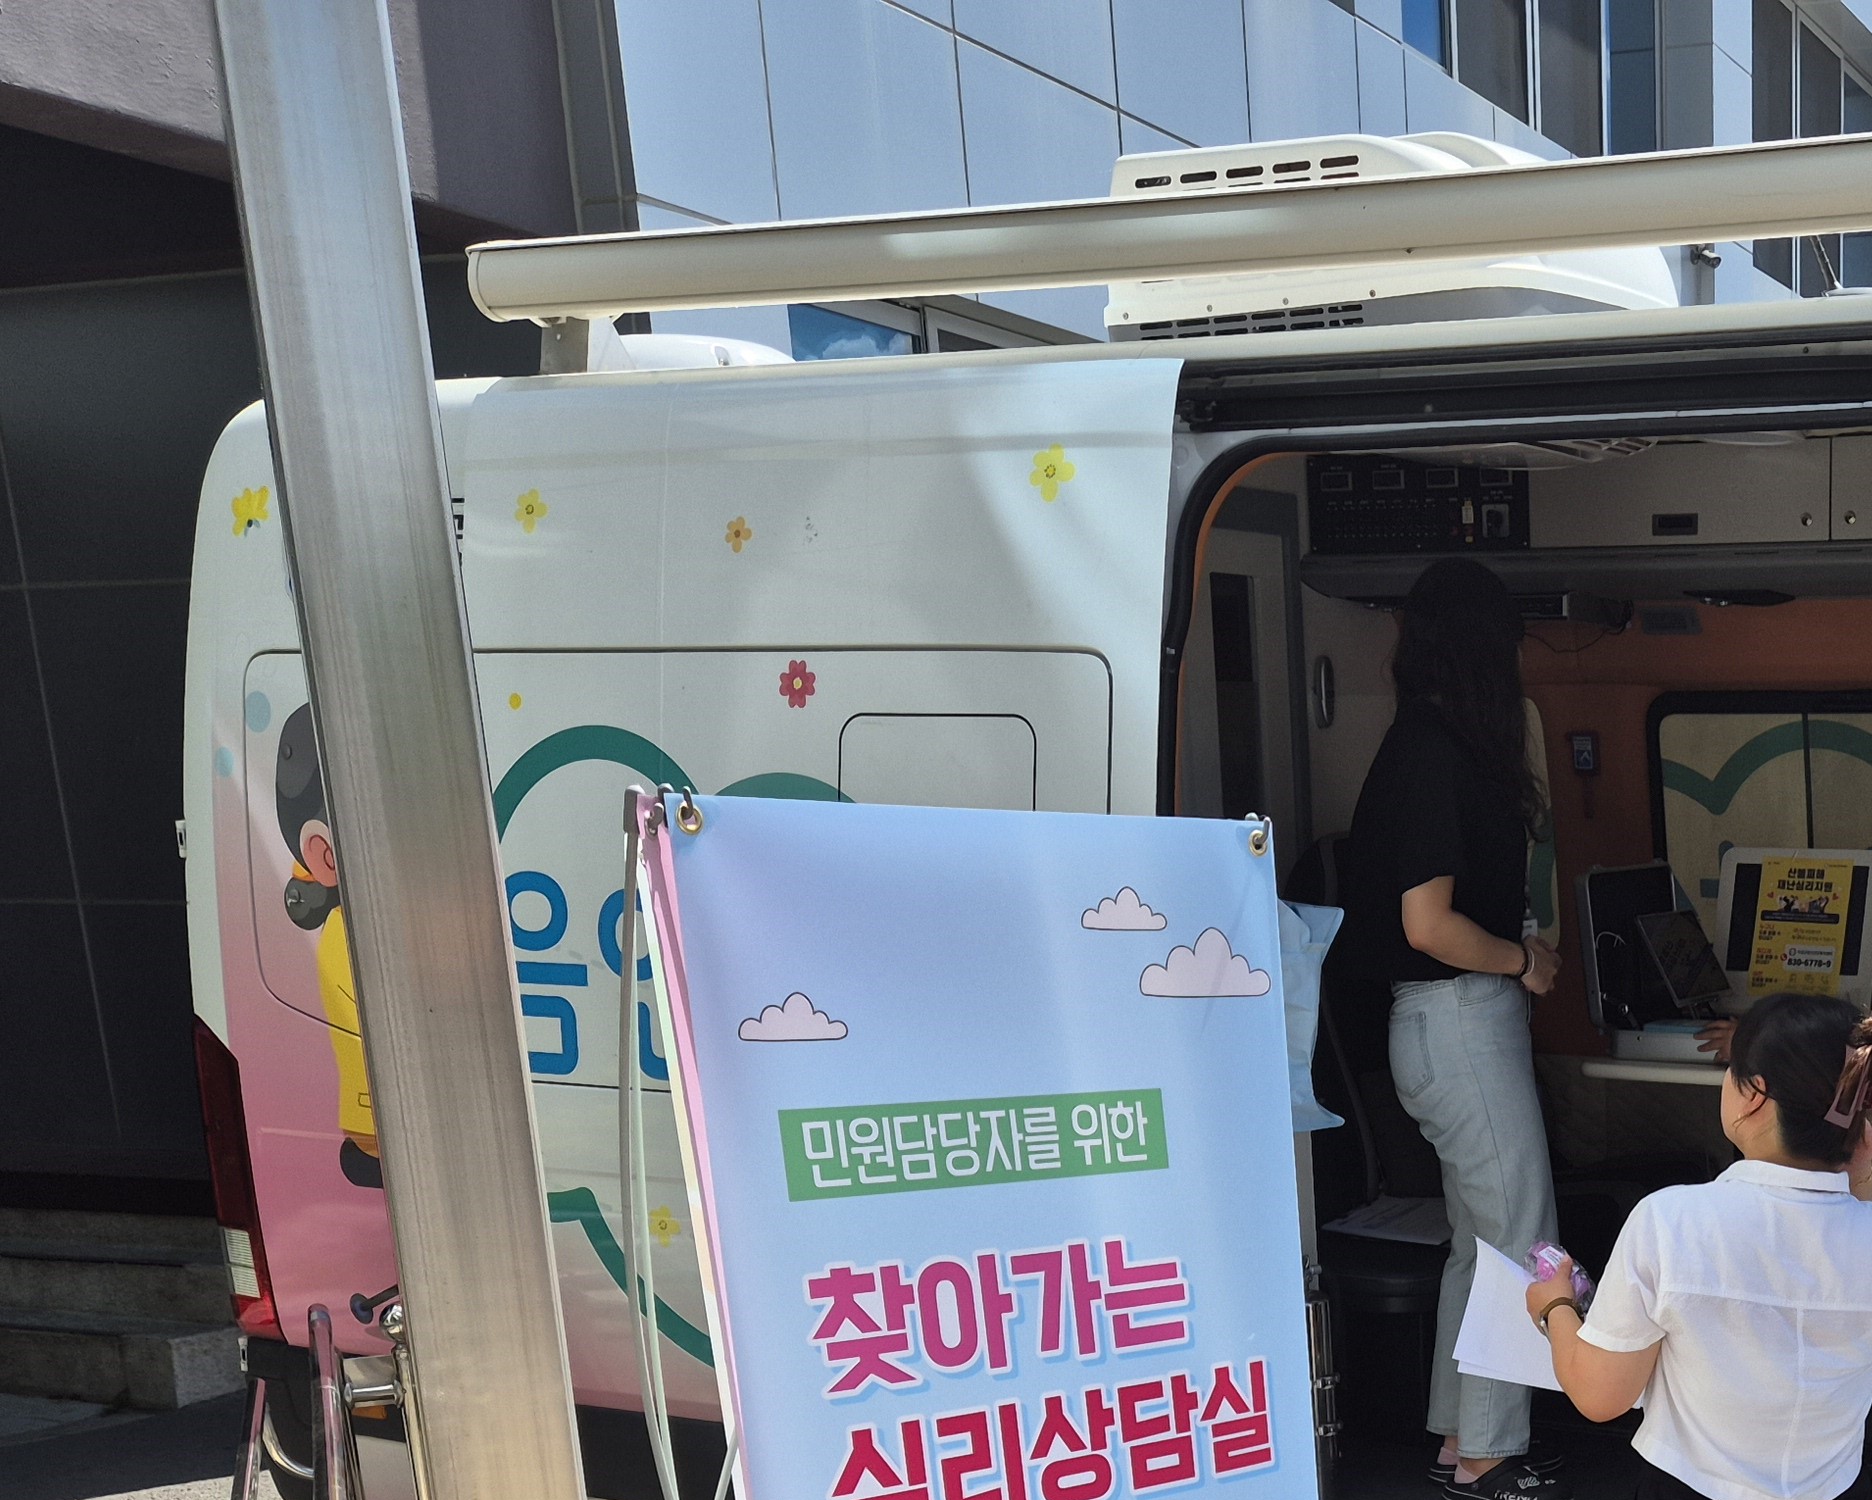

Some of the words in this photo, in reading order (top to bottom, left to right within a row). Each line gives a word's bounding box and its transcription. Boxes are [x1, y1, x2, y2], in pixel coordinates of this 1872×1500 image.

[1777, 879, 1834, 893] 재난심리지원
[800, 1104, 1061, 1189] 민원담당자를
[1069, 1101, 1149, 1167] 위한
[806, 1239, 1190, 1394] 찾아가는
